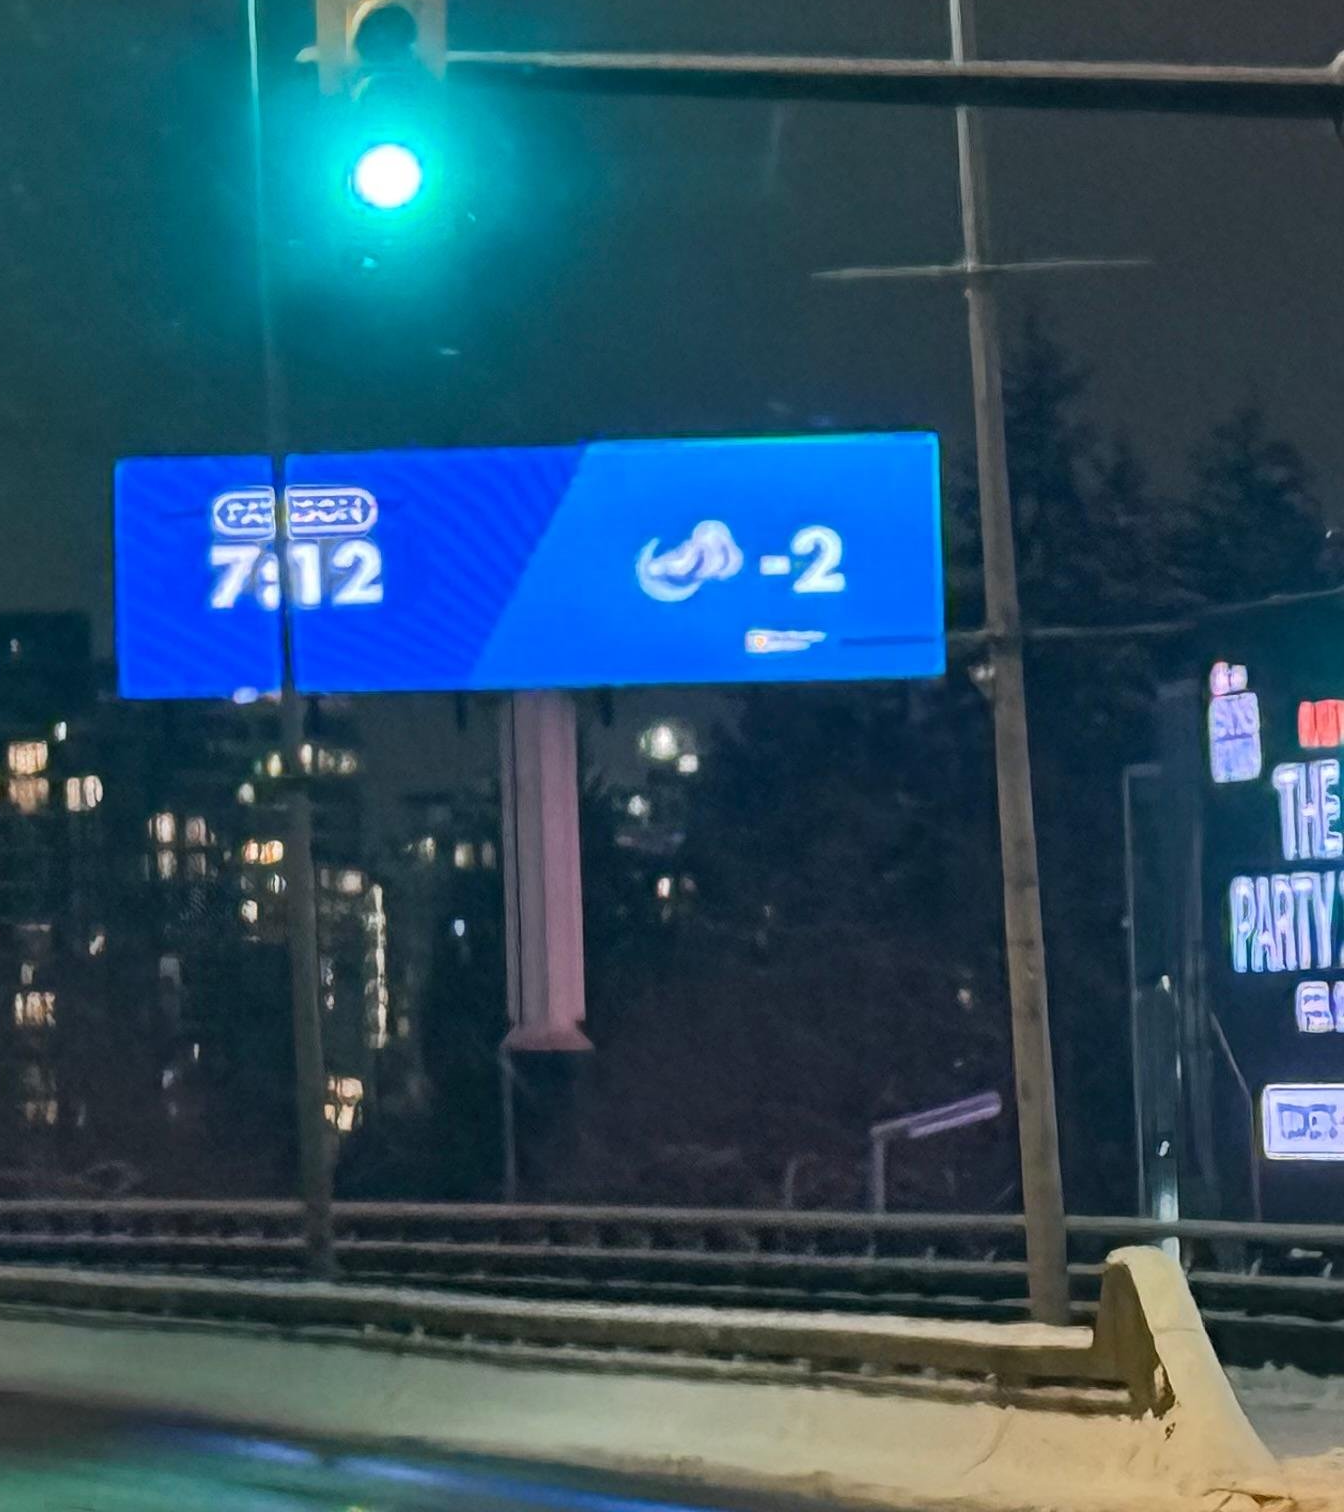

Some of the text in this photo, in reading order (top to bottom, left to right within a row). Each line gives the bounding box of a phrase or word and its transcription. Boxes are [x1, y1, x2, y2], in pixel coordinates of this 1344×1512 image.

[210, 539, 383, 610] 7:12
[759, 524, 846, 593] -2
[1272, 759, 1344, 861] THE
